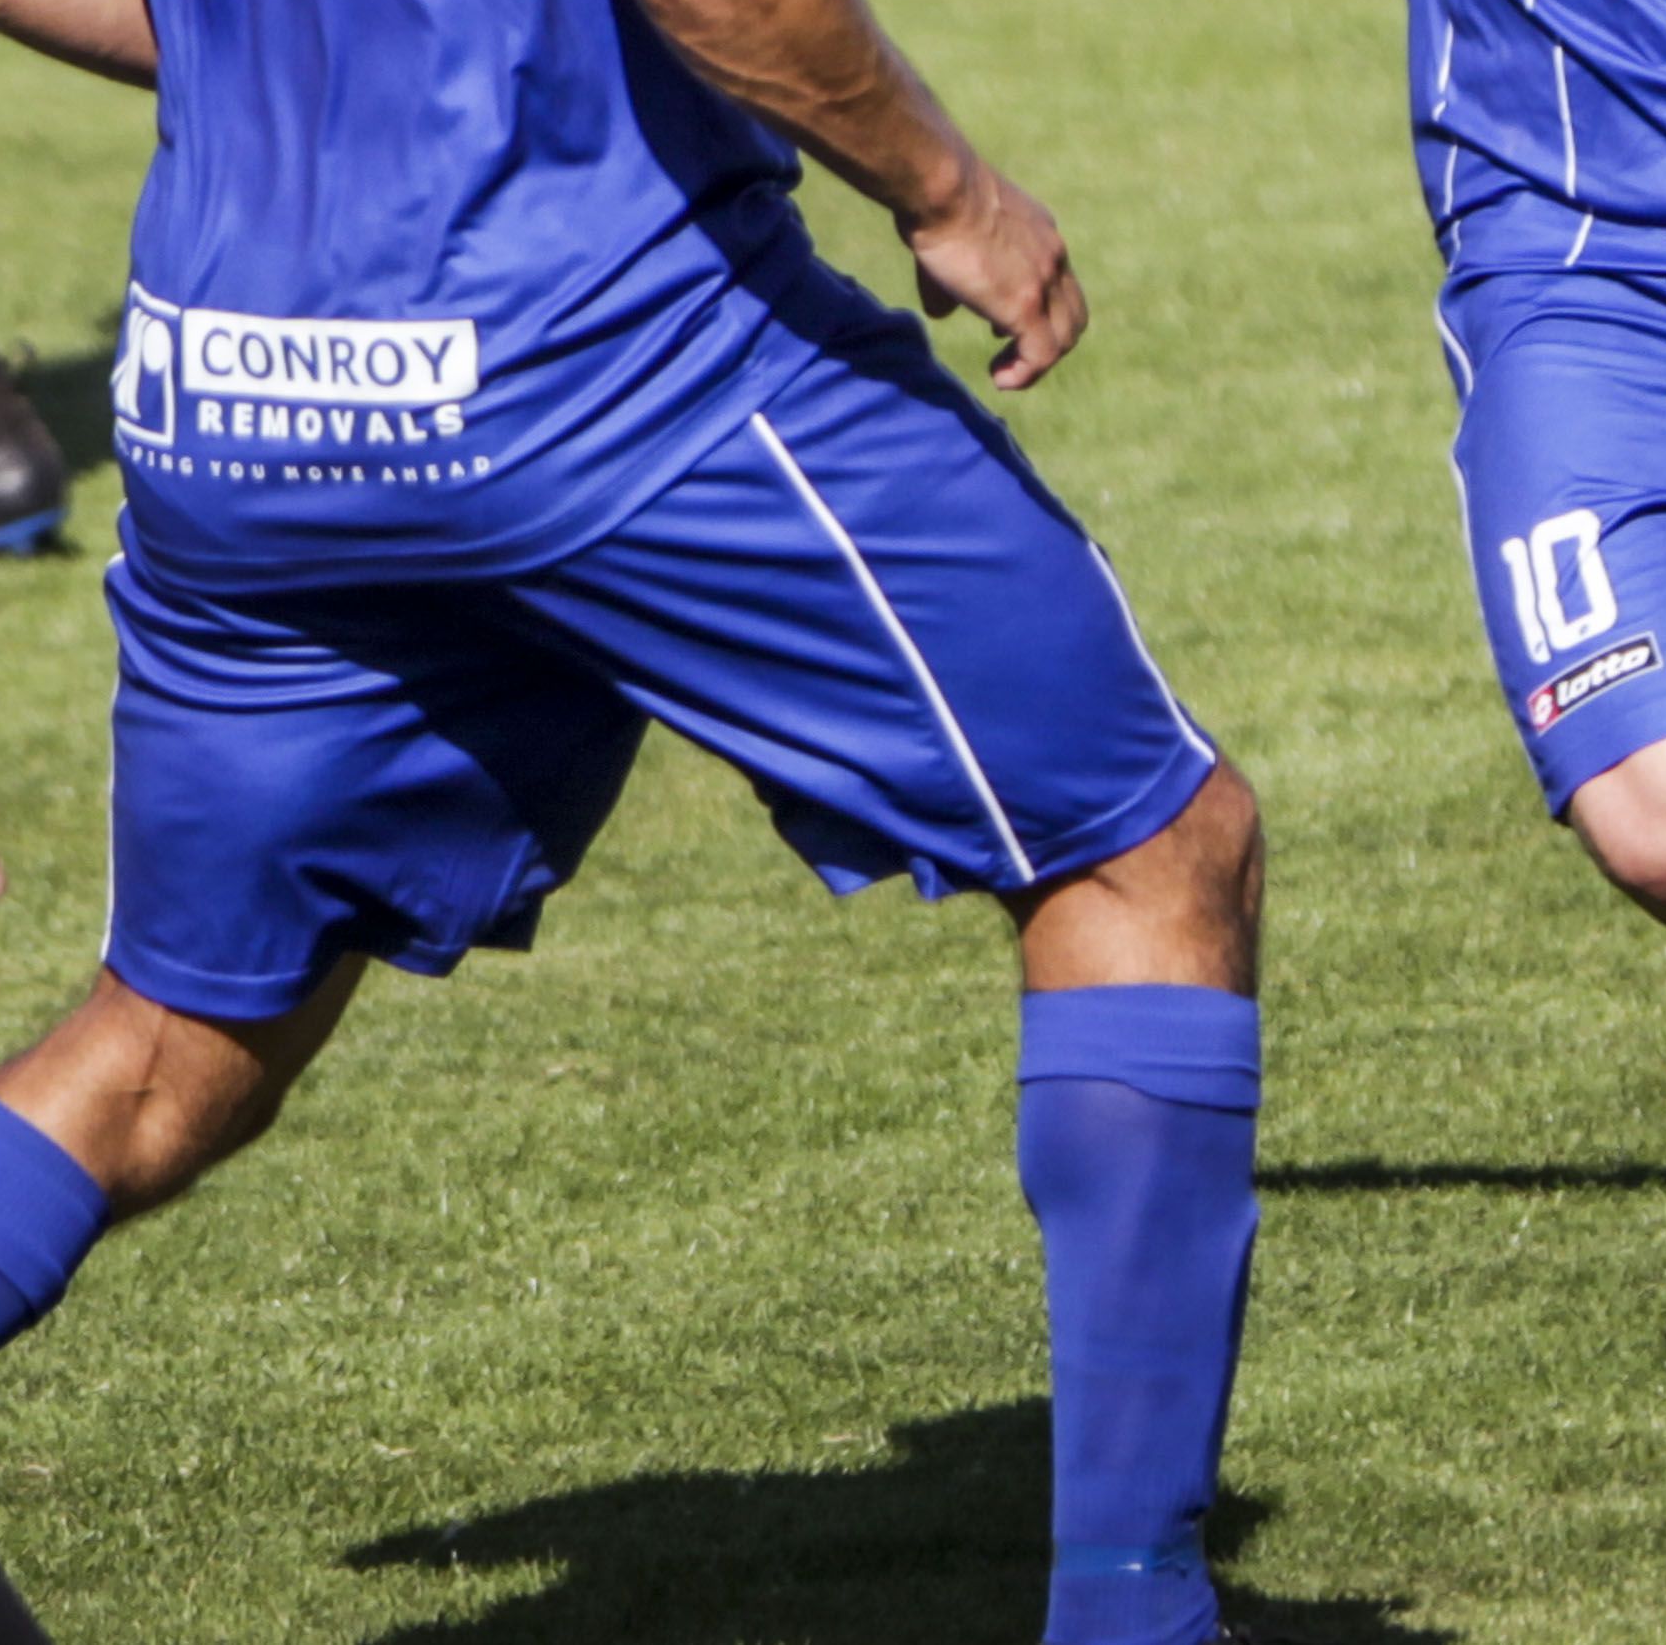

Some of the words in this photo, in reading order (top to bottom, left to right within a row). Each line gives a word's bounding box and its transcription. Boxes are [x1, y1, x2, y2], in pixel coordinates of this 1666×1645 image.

[201, 326, 454, 387] CONROY
[196, 399, 465, 444] REMOVALS
[209, 460, 266, 481] YOU
[284, 464, 365, 482] MOVE
[382, 455, 491, 483] AHEAD
[1501, 508, 1618, 664] 10
